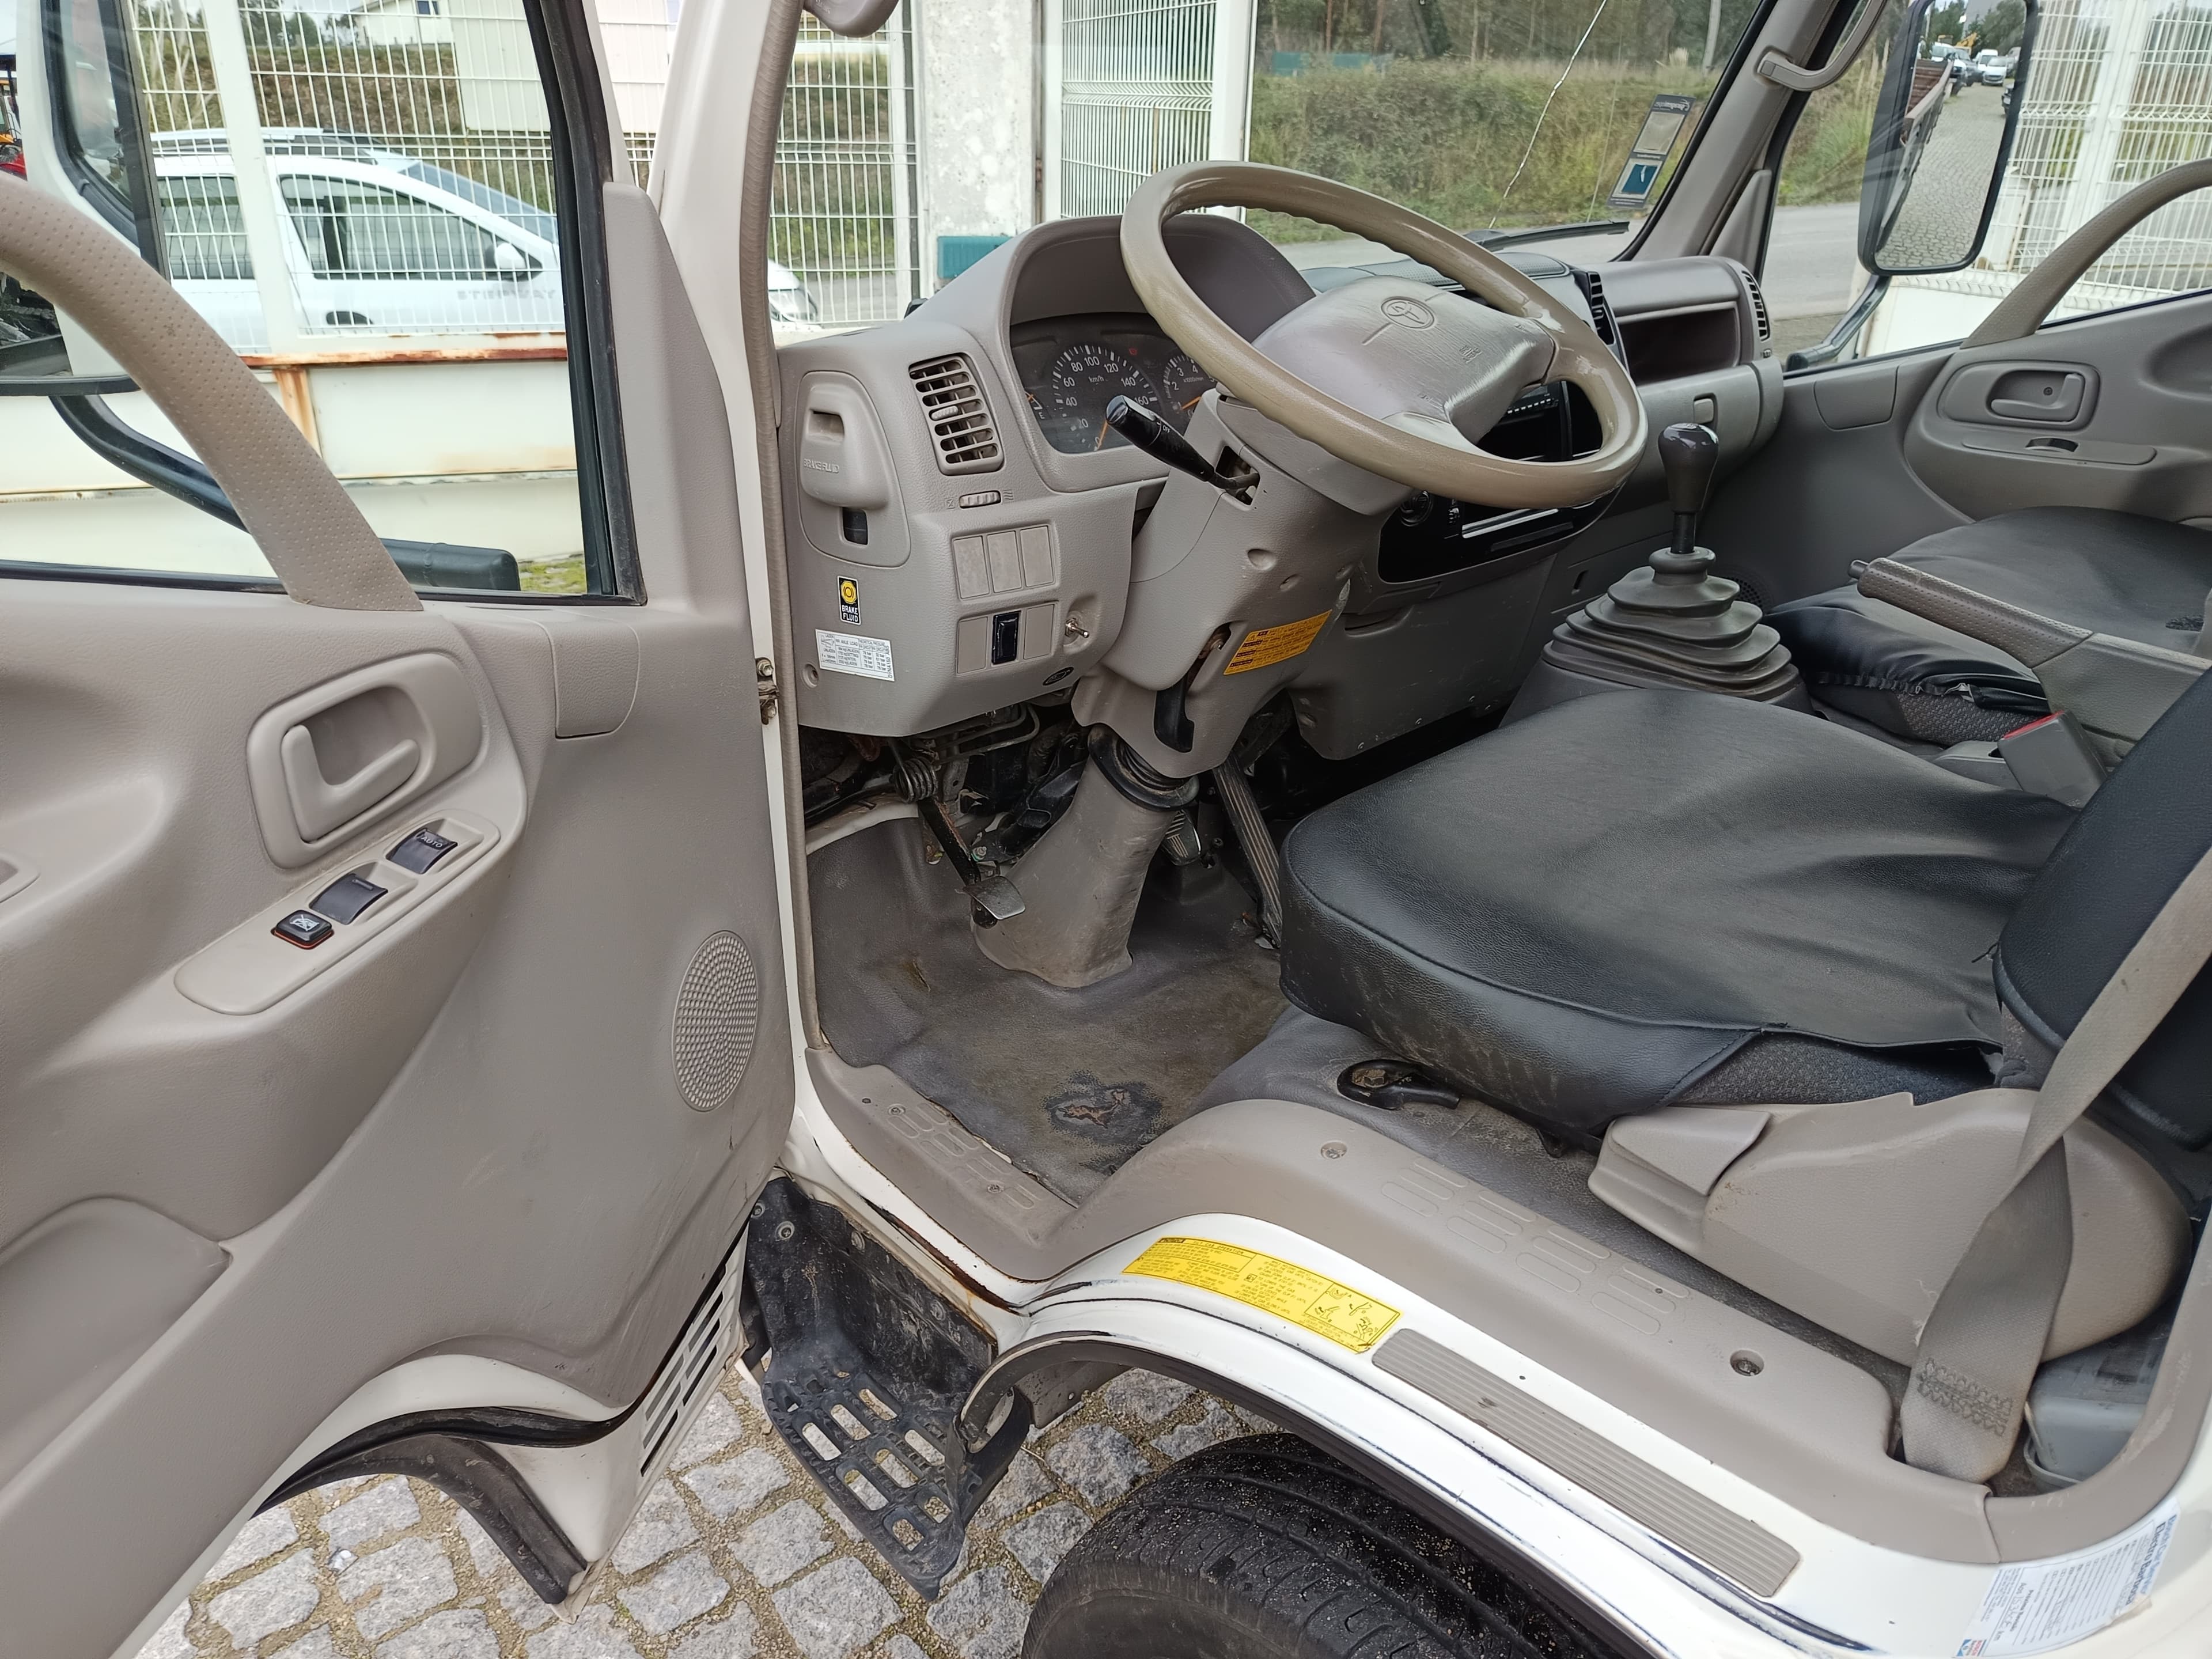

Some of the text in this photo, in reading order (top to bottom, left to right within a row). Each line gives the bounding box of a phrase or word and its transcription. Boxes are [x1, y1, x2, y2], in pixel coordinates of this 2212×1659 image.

[1084, 356, 1100, 366] 100
[1071, 362, 1083, 372] 80
[1104, 363, 1119, 373] 120
[1177, 368, 1184, 376] 3
[1192, 365, 1198, 373] 4
[1063, 377, 1075, 387] 60
[1120, 377, 1136, 387] 140
[1172, 381, 1179, 390] 2
[1066, 397, 1077, 407] 40
[1162, 425, 1171, 434] OFF
[842, 604, 858, 615] BRAKE
[843, 612, 858, 622] FLUID
[421, 836, 442, 847] AUTO
[2126, 1522, 2166, 1605] Electro Barbosa
